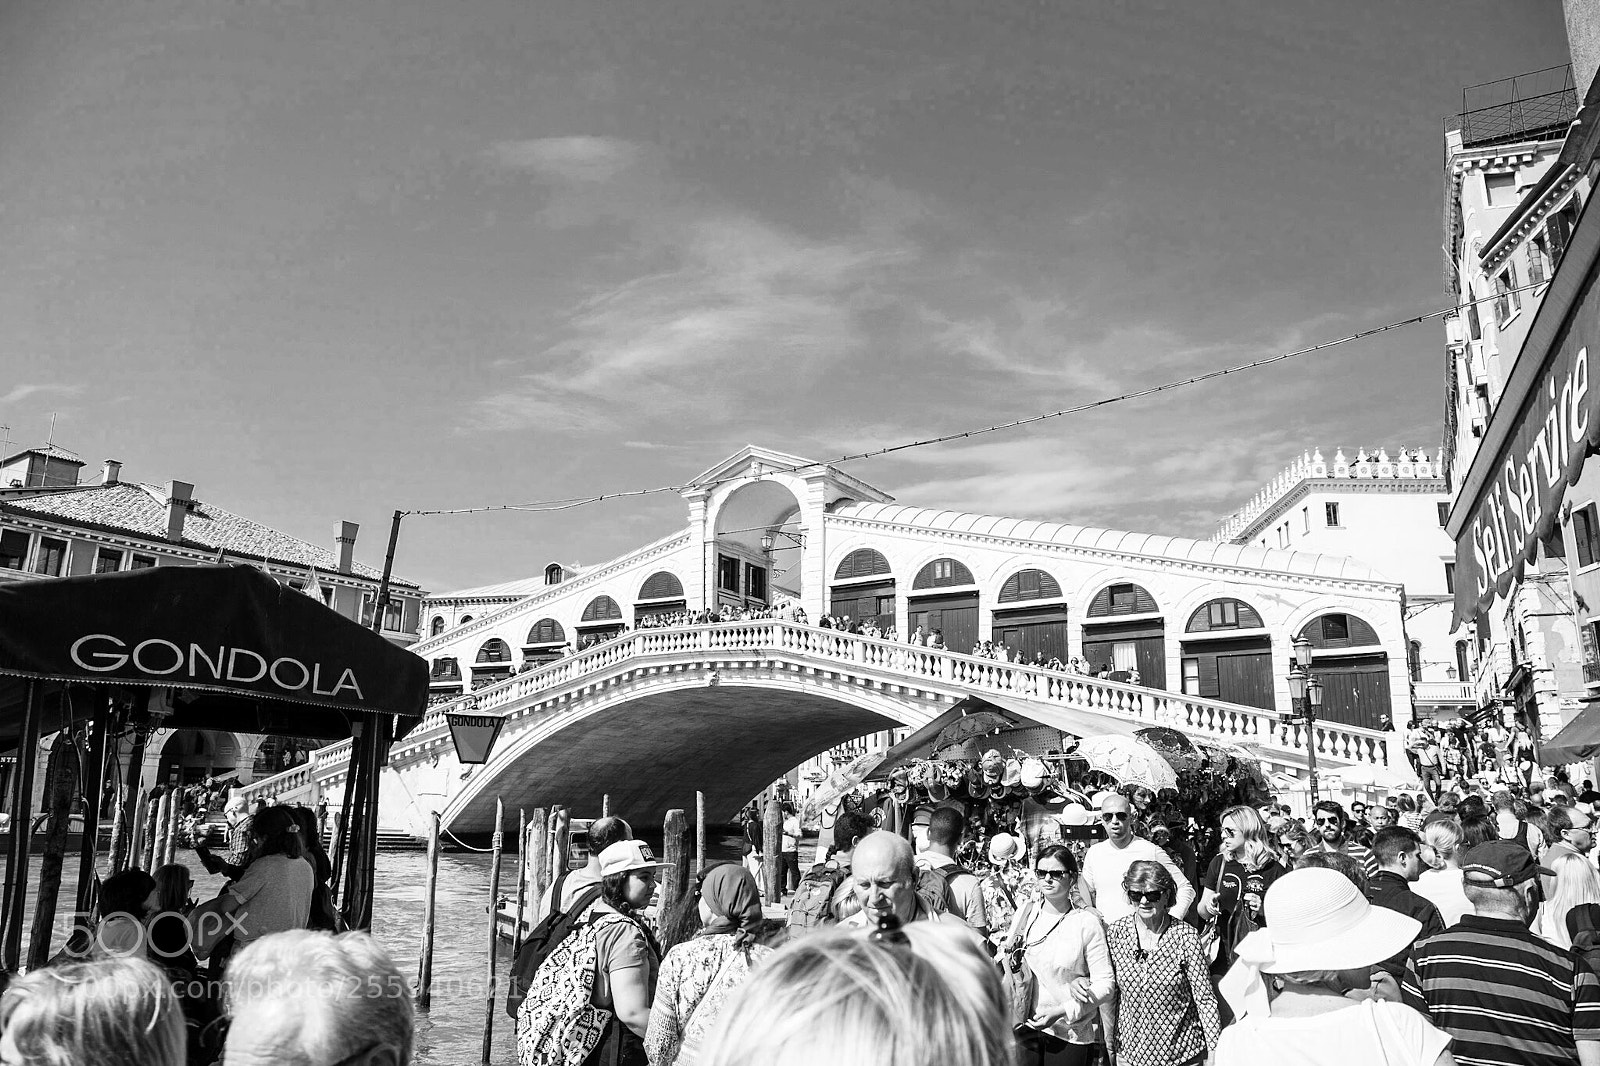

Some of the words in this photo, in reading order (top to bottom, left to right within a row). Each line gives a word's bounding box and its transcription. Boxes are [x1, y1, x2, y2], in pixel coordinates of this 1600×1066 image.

[1473, 481, 1513, 597] Self
[1505, 346, 1589, 554] Service
[70, 634, 364, 699] GONDOLA
[451, 716, 495, 728] GONDOLA
